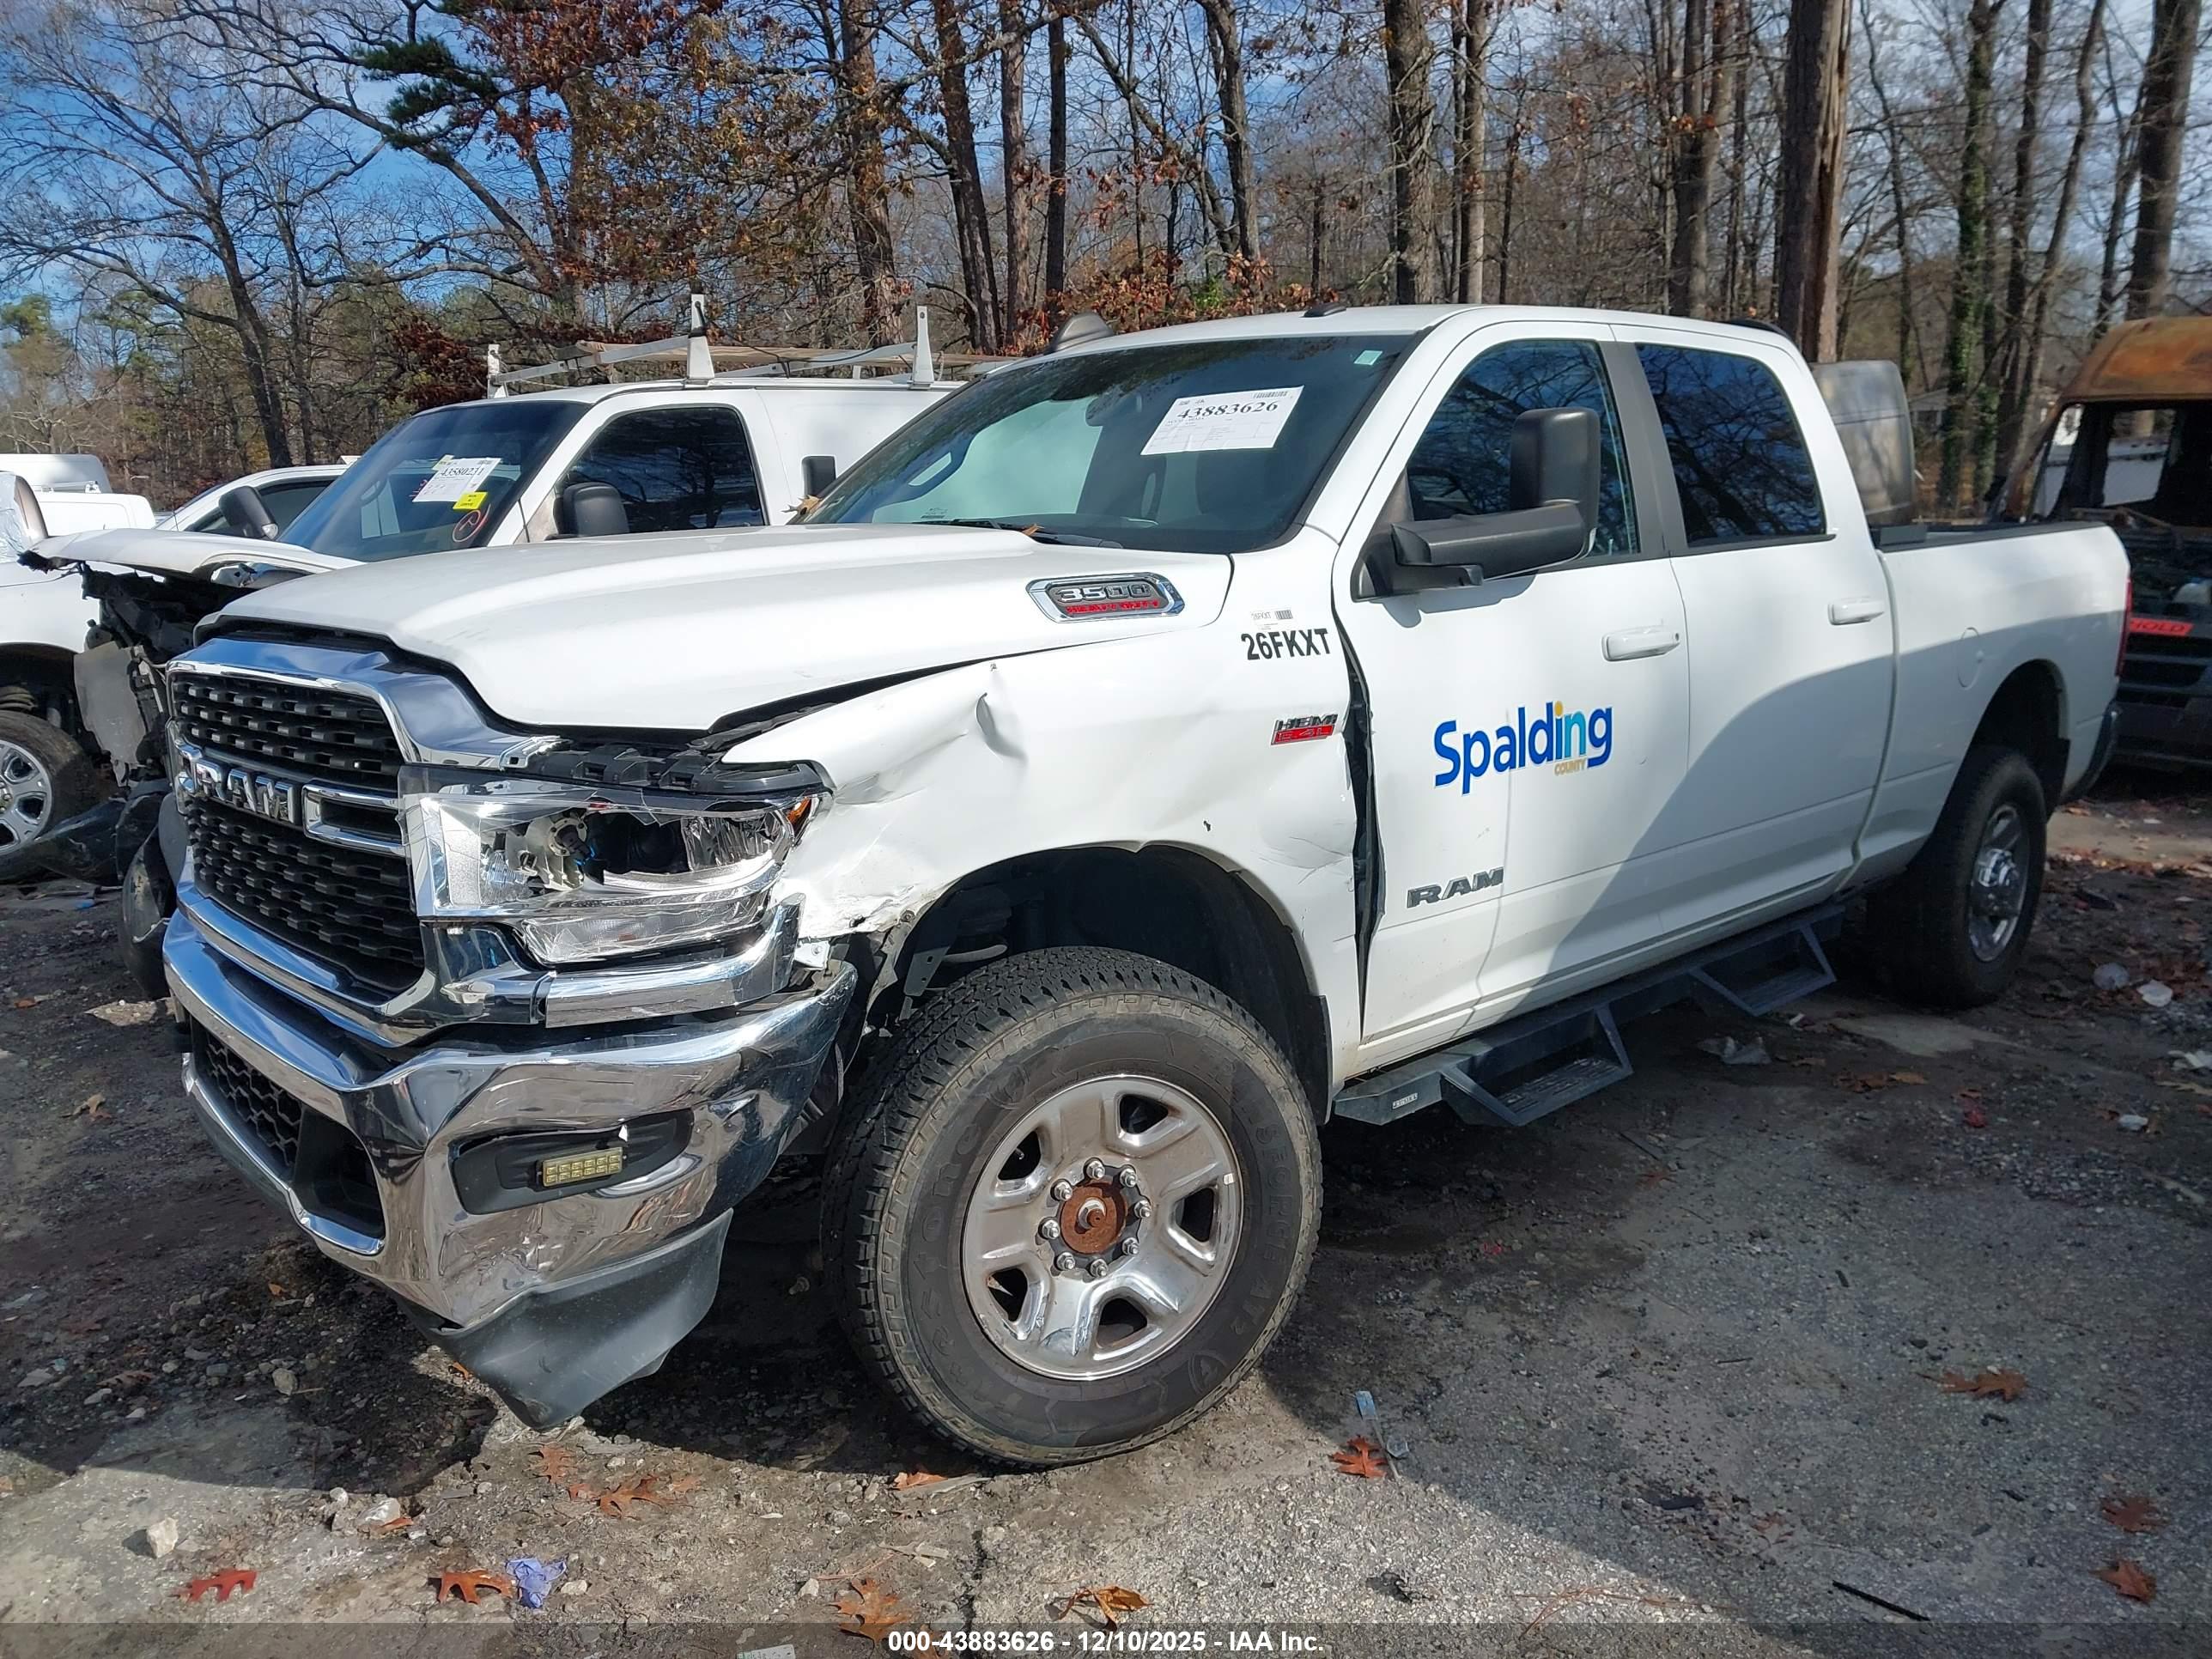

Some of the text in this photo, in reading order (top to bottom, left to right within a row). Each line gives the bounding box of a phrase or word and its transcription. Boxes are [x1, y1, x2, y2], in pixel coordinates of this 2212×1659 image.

[1177, 400, 1279, 418] 43883626
[1056, 583, 1152, 603] 3500
[1241, 628, 1330, 660] 26FKXT
[1433, 701, 1612, 794] Spalding
[1553, 758, 1586, 775] COUNTY
[195, 758, 300, 824] RAM
[1407, 866, 1504, 908] RAM
